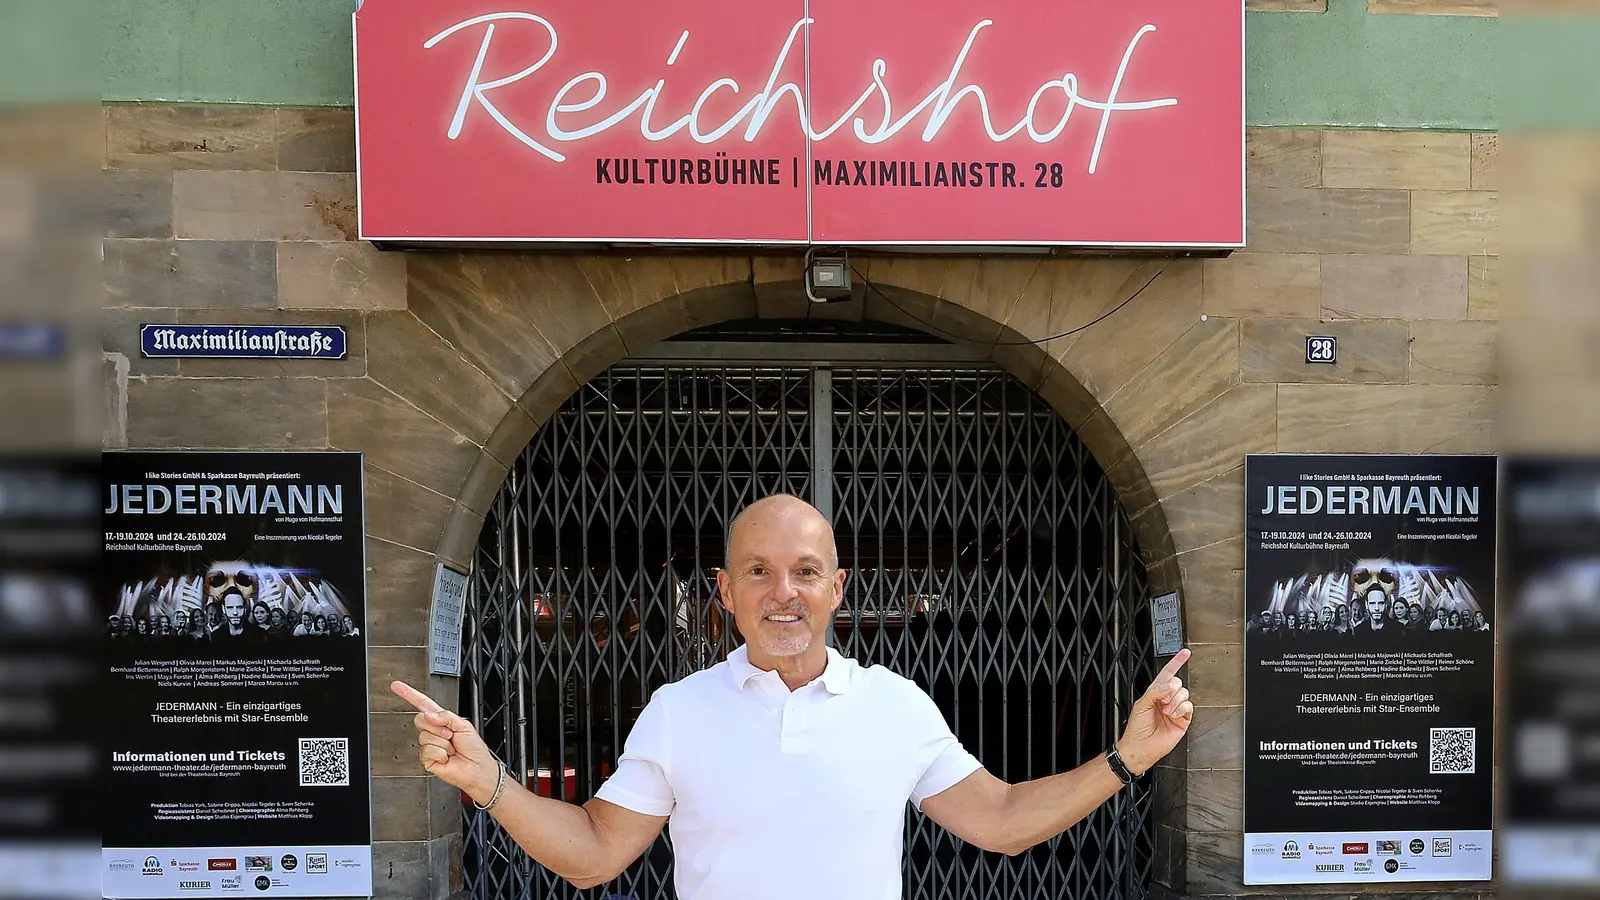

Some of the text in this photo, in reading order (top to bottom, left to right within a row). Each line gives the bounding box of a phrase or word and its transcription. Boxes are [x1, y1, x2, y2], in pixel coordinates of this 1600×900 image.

[424, 12, 1177, 174] Reichshof
[597, 152, 780, 184] KULTURBÜHNE
[815, 160, 1024, 187] MAXIMILIANSTR.
[1035, 163, 1063, 188] 28
[1312, 340, 1332, 359] 28
[207, 472, 238, 480] Sparkasse
[266, 472, 300, 480] präsentiert:
[105, 485, 342, 514] JEDERMANN
[1262, 486, 1478, 514] JEDERMANN
[105, 532, 153, 540] 17.-19.10.2024
[157, 532, 172, 540] und
[175, 544, 202, 552] Bayreuth
[1325, 542, 1349, 550] Bayreuth
[1301, 694, 1356, 702] JEDERMANN
[1366, 693, 1378, 701] Ein
[1381, 693, 1433, 703] einzigartiges
[156, 702, 217, 710] JEDERMANN
[227, 702, 240, 710] Ein
[243, 701, 301, 712] einzigartiges
[1296, 705, 1361, 713] Theatererlebnis
[1379, 704, 1440, 712] Star-Ensemble
[151, 713, 308, 722] Theatererlebnis mit Star-Ensemble
[1260, 740, 1417, 750] Informationen und Tickets
[113, 750, 285, 761] Informationen und Tickets
[1259, 752, 1418, 760] www.jedermann-theater.de/jedermann-bayreuth
[113, 763, 286, 772] www.jedermann-theater.de/jedermann-bayreuth
